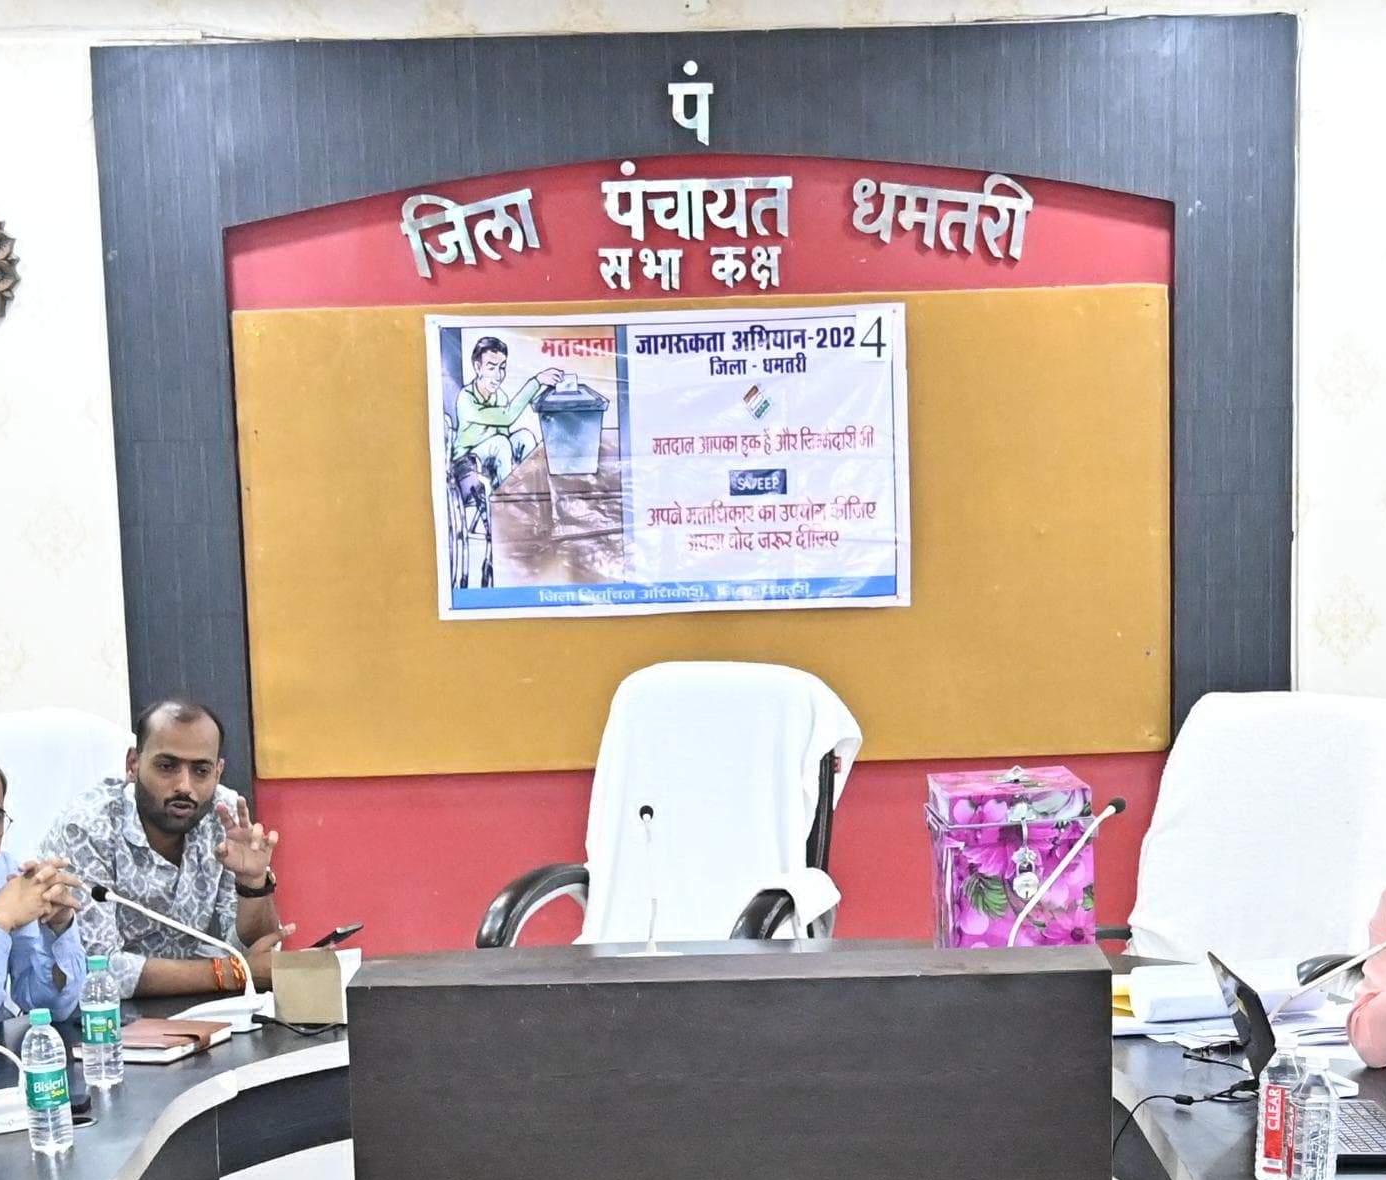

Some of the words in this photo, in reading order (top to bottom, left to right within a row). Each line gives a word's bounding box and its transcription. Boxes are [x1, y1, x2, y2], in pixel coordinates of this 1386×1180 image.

[668, 60, 712, 145] पं
[401, 188, 540, 278] जिला
[600, 161, 793, 241] पंचायत
[851, 173, 1034, 260] धमतरी
[599, 247, 682, 291] सभा
[711, 246, 781, 290] कक्ष
[542, 336, 615, 357] मतदाता
[710, 354, 746, 376] जिला
[763, 353, 806, 374] धमतरी
[699, 434, 737, 456] आपका
[776, 427, 798, 452] और
[647, 501, 682, 526] अपने
[758, 505, 776, 522] का
[1267, 1088, 1281, 1131] CLEAR
